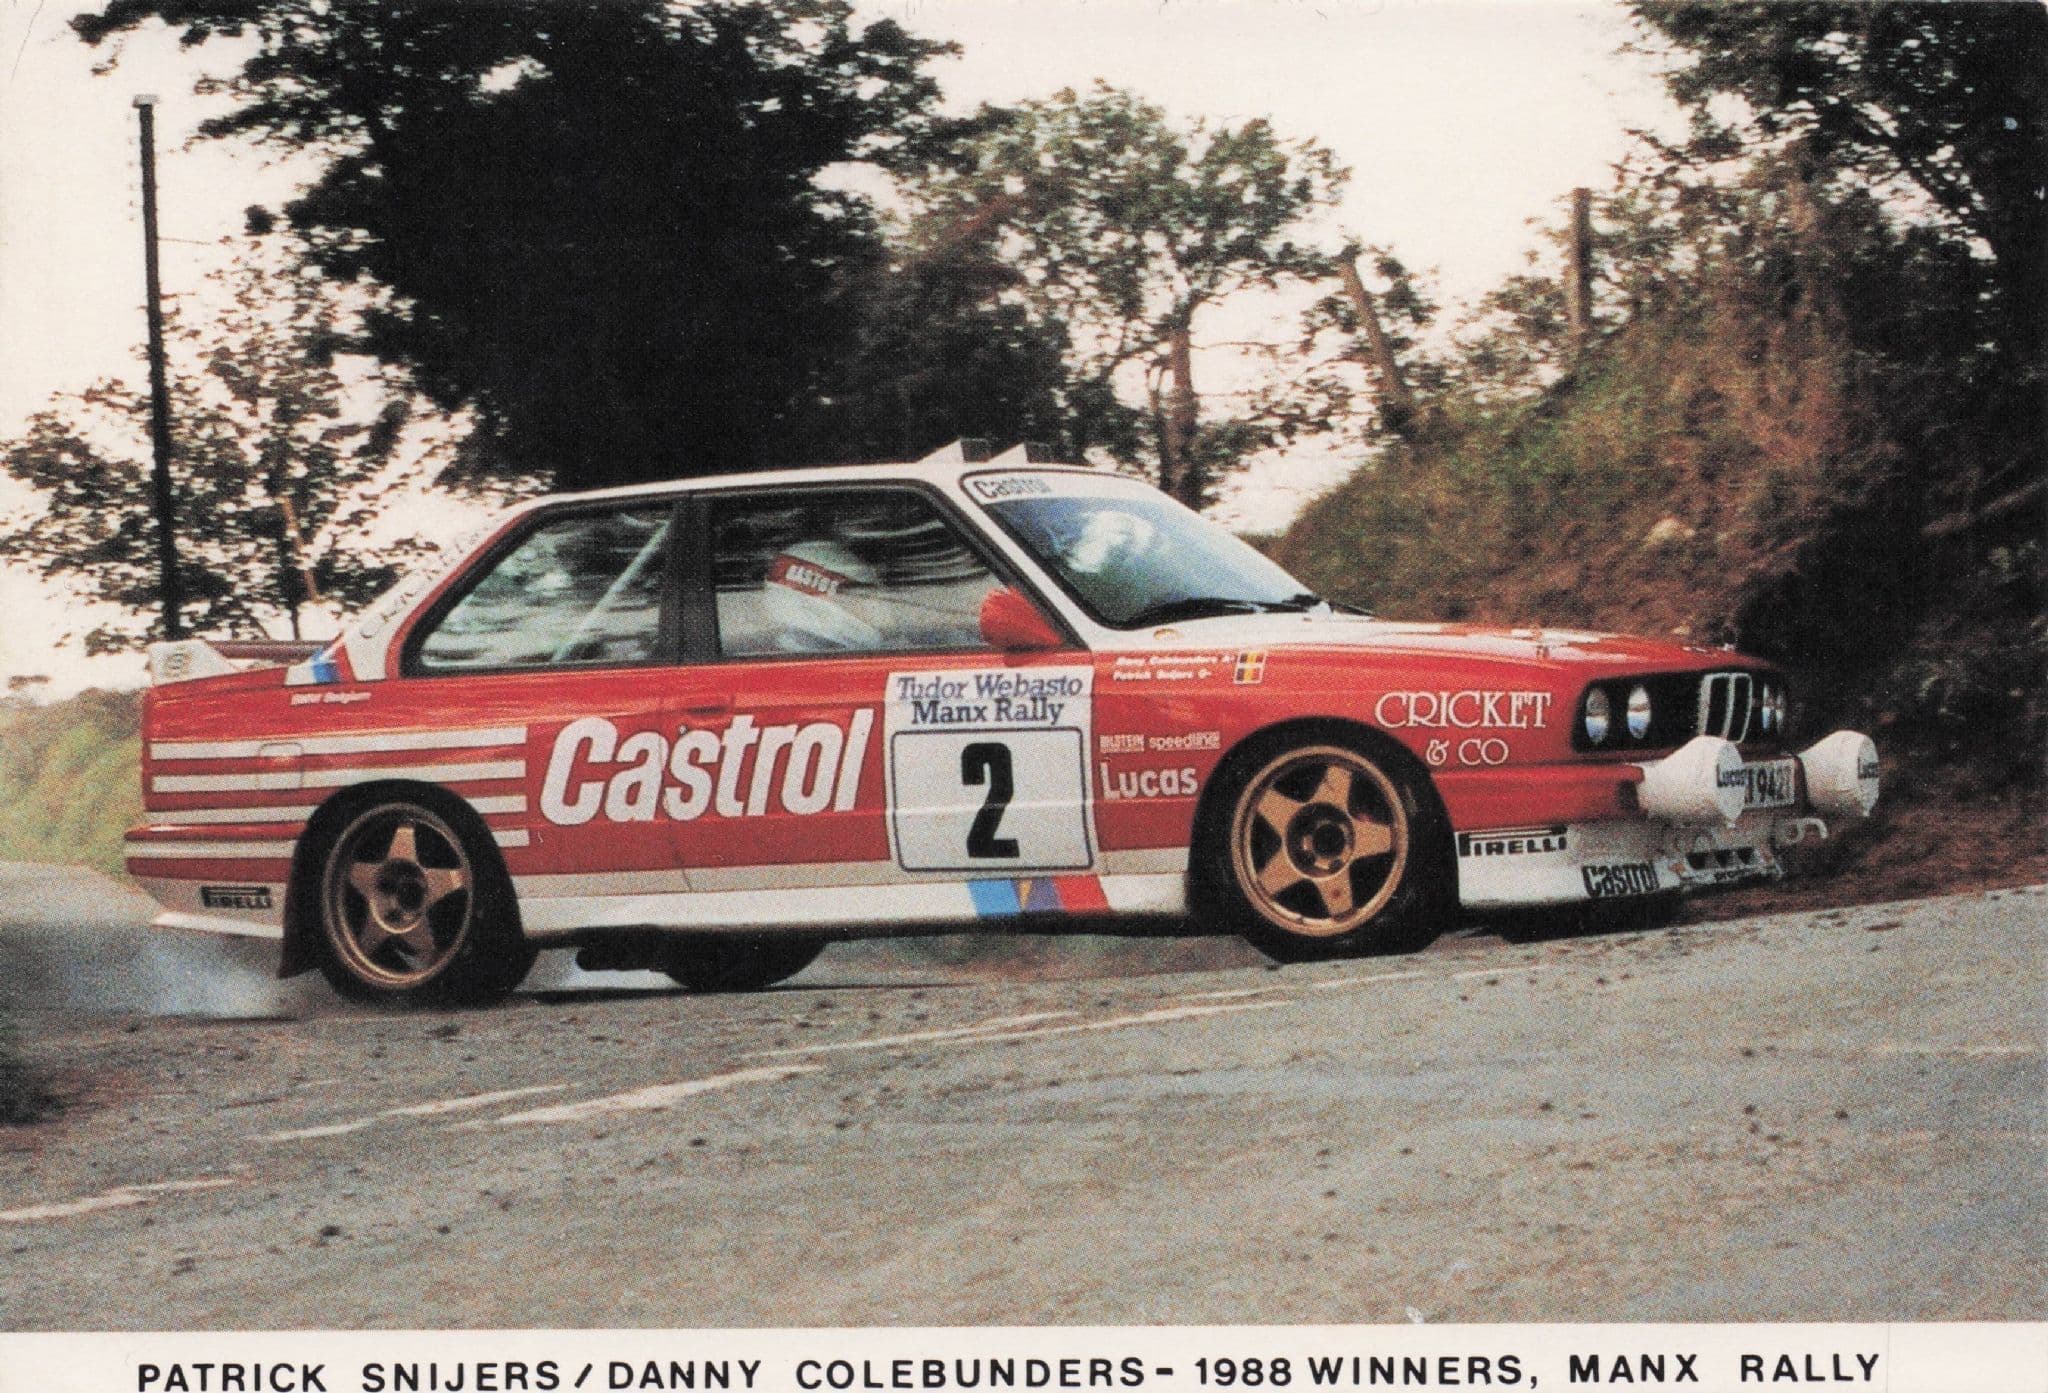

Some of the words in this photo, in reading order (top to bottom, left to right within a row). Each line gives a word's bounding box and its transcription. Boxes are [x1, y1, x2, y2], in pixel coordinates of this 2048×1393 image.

[898, 676, 968, 700] Tudor
[973, 674, 1083, 698] Webasto
[912, 700, 988, 724] Manx
[994, 697, 1064, 726] Rally
[1374, 689, 1552, 729] CRICKET
[540, 708, 874, 825] Castrol
[1426, 739, 1450, 766] &
[1458, 738, 1509, 766] CO
[1100, 760, 1198, 800] Lucas
[961, 742, 1020, 858] 2
[1459, 823, 1568, 857] PIRELLI
[1582, 860, 1660, 898] Castrol
